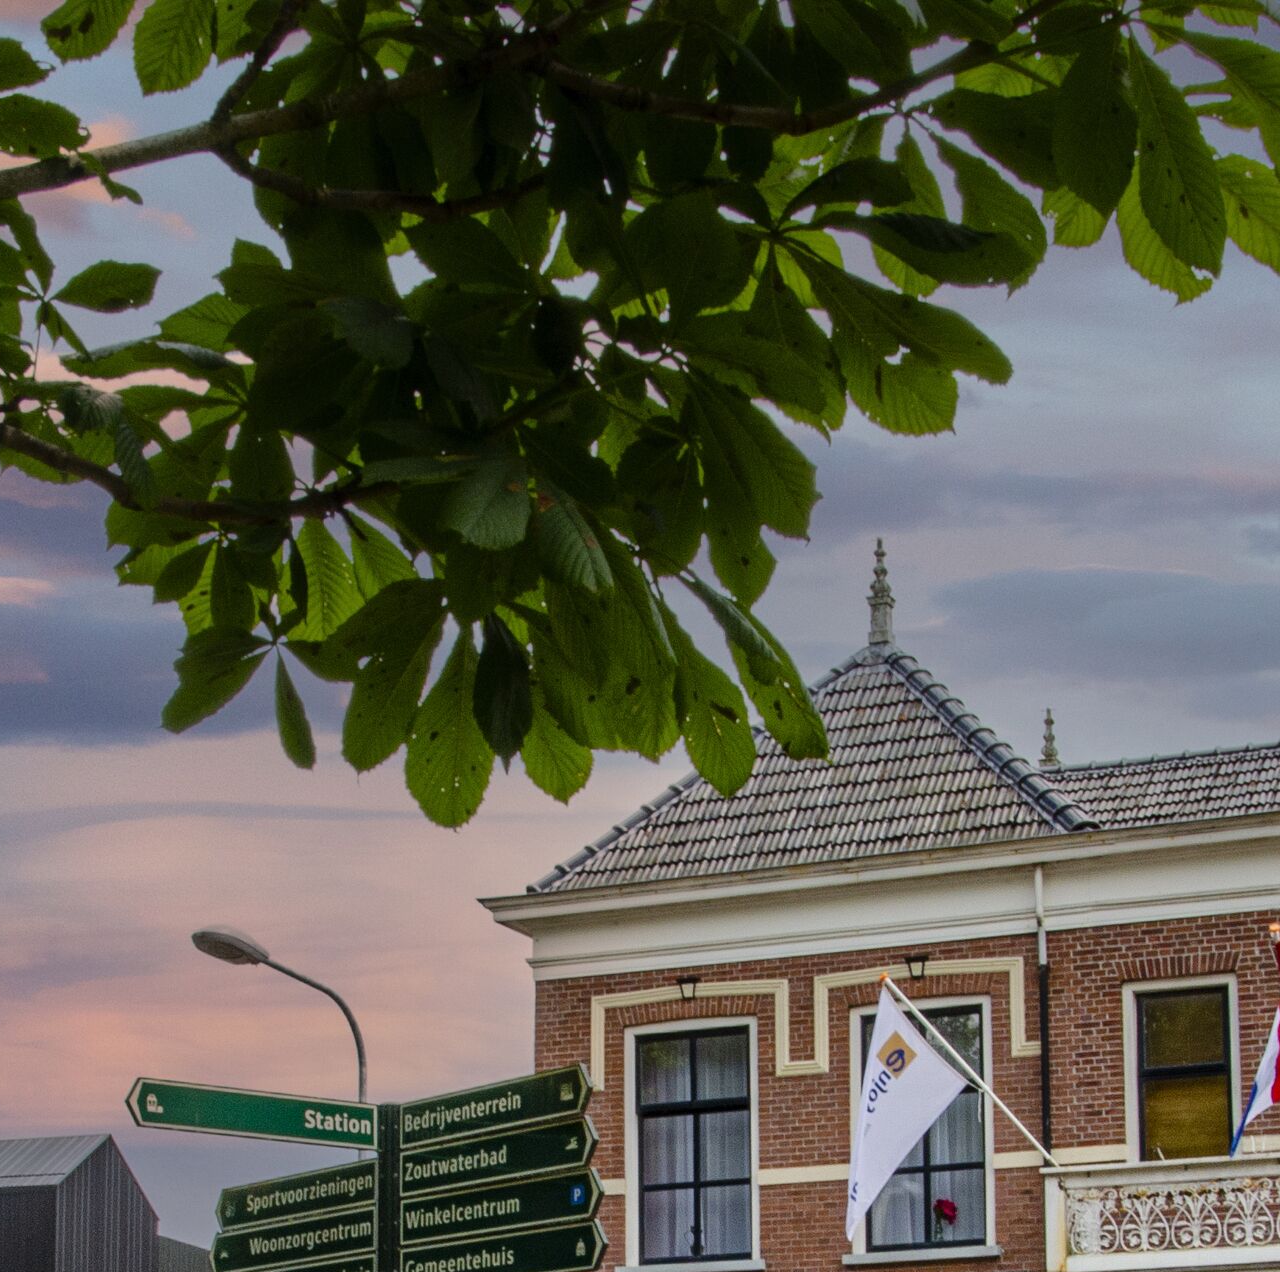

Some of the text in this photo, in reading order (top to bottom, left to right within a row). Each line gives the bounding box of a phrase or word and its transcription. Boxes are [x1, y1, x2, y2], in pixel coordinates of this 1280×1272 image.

[304, 1109, 371, 1135] Station
[404, 1091, 521, 1133] Bedrijventerrein
[404, 1145, 507, 1182] Zoutwaterbad
[246, 1174, 373, 1214] Sportvoorzieningen
[405, 1187, 582, 1230] Winkelcentrum P
[249, 1220, 372, 1256] Woonzorgcentrum
